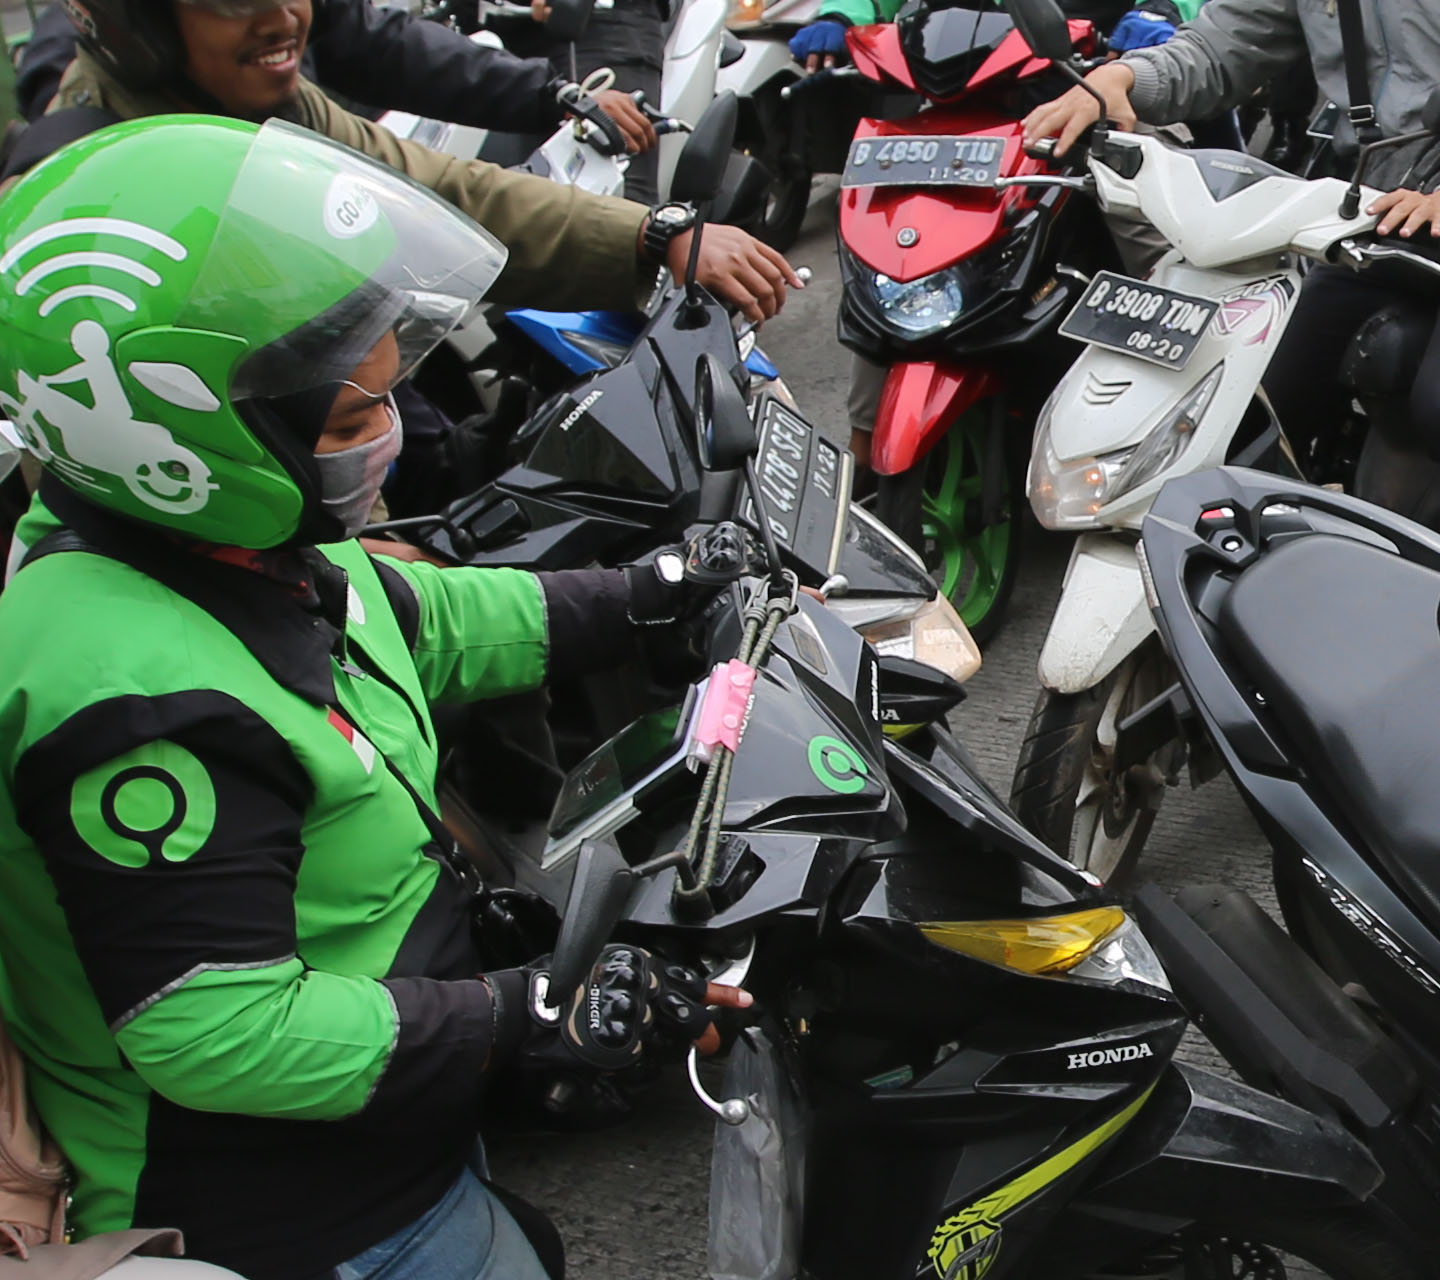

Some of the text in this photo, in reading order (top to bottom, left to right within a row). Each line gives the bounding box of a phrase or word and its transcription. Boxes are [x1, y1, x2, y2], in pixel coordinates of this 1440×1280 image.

[854, 140, 997, 166] B 4850 TIU
[1086, 280, 1111, 308] B
[1106, 284, 1161, 322] 3908
[559, 388, 604, 432] HONDA
[762, 449, 800, 514] 4478
[1066, 1041, 1154, 1070] HONDA
